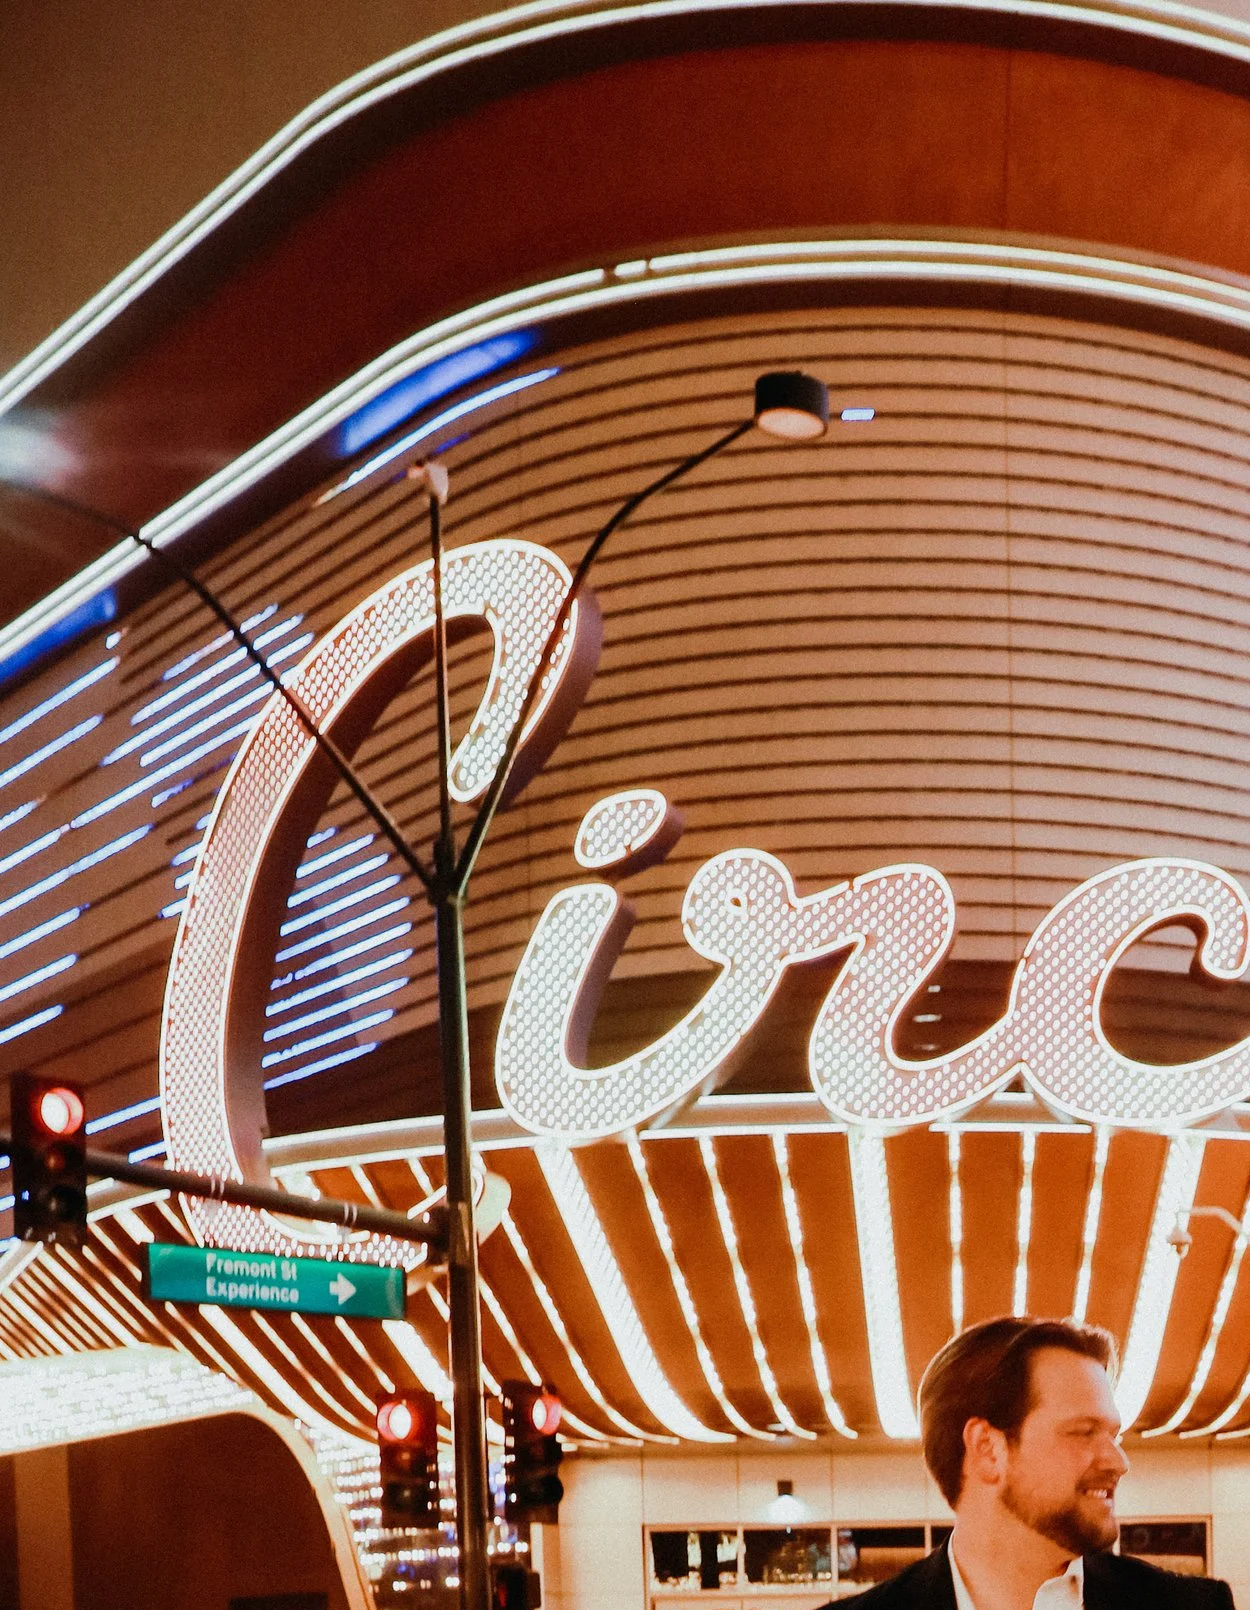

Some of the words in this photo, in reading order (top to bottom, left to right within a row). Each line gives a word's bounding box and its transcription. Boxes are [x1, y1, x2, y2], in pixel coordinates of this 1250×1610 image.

[206, 1252, 277, 1278] Fremont
[281, 1260, 298, 1281] St
[206, 1276, 299, 1303] Experience
